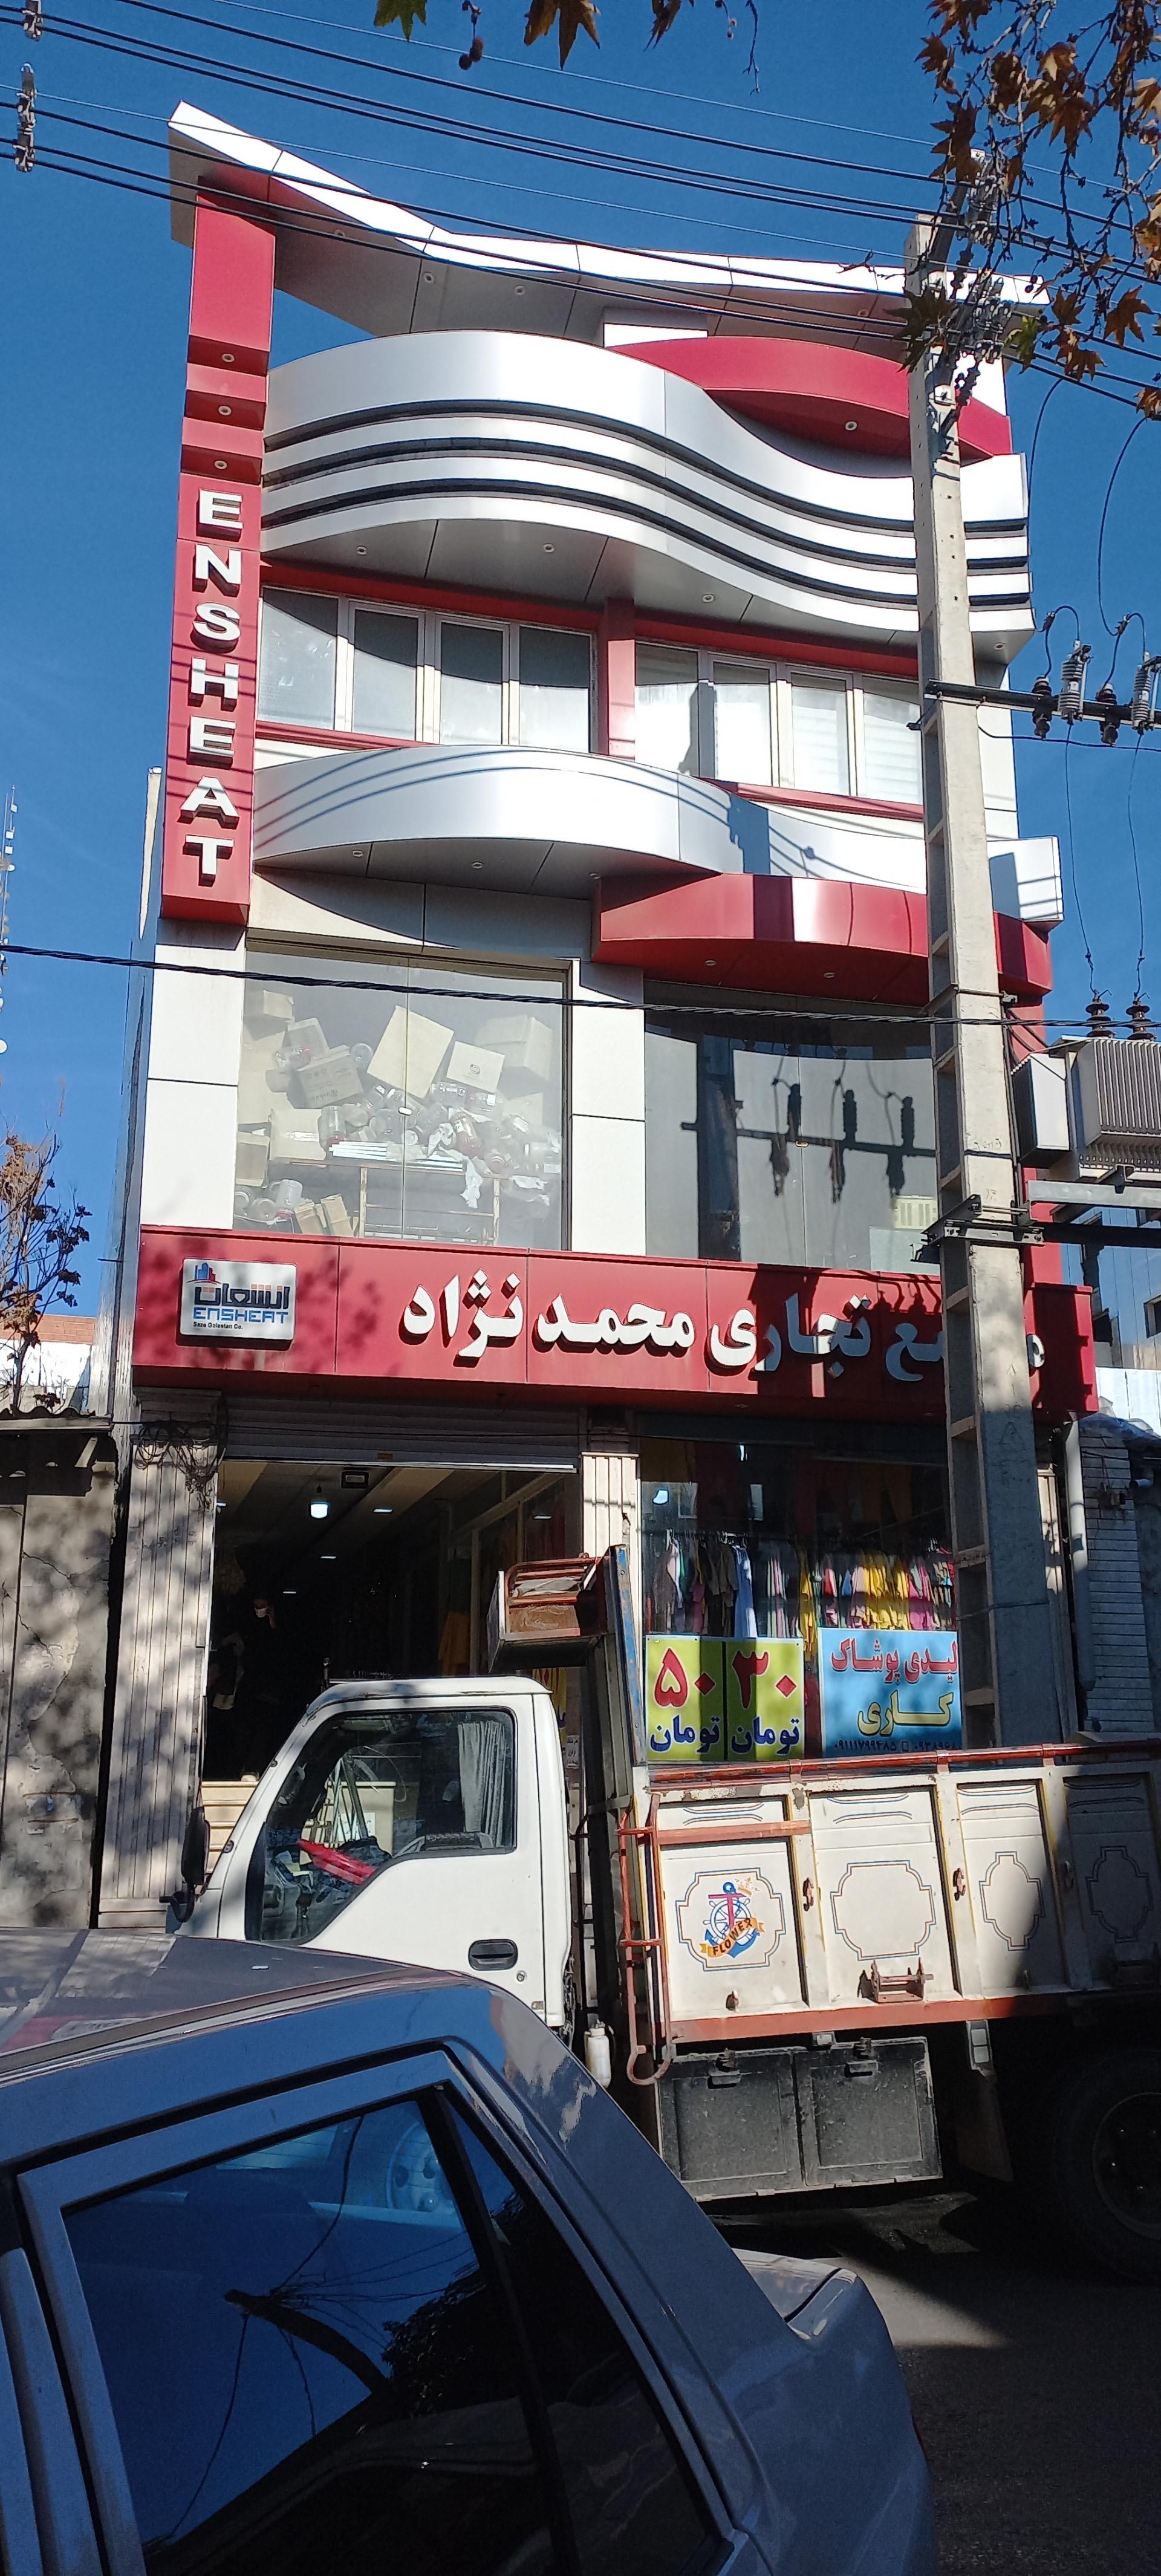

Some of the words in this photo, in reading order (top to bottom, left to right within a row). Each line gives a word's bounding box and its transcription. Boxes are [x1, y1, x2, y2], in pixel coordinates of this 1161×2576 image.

[180, 489, 243, 877] ENSHEAT
[193, 1307, 288, 1324] ENSHEAT
[403, 1268, 524, 1357] نژاد
[537, 1293, 695, 1348] محمد
[711, 1292, 871, 1378] تجاری
[830, 1638, 899, 1685] پوشاک
[905, 1639, 958, 1683] لیدی
[650, 1714, 721, 1754] تومان
[731, 1716, 801, 1755] تومان
[857, 1690, 954, 1737] کاری
[712, 1917, 753, 1956] FLOWER
